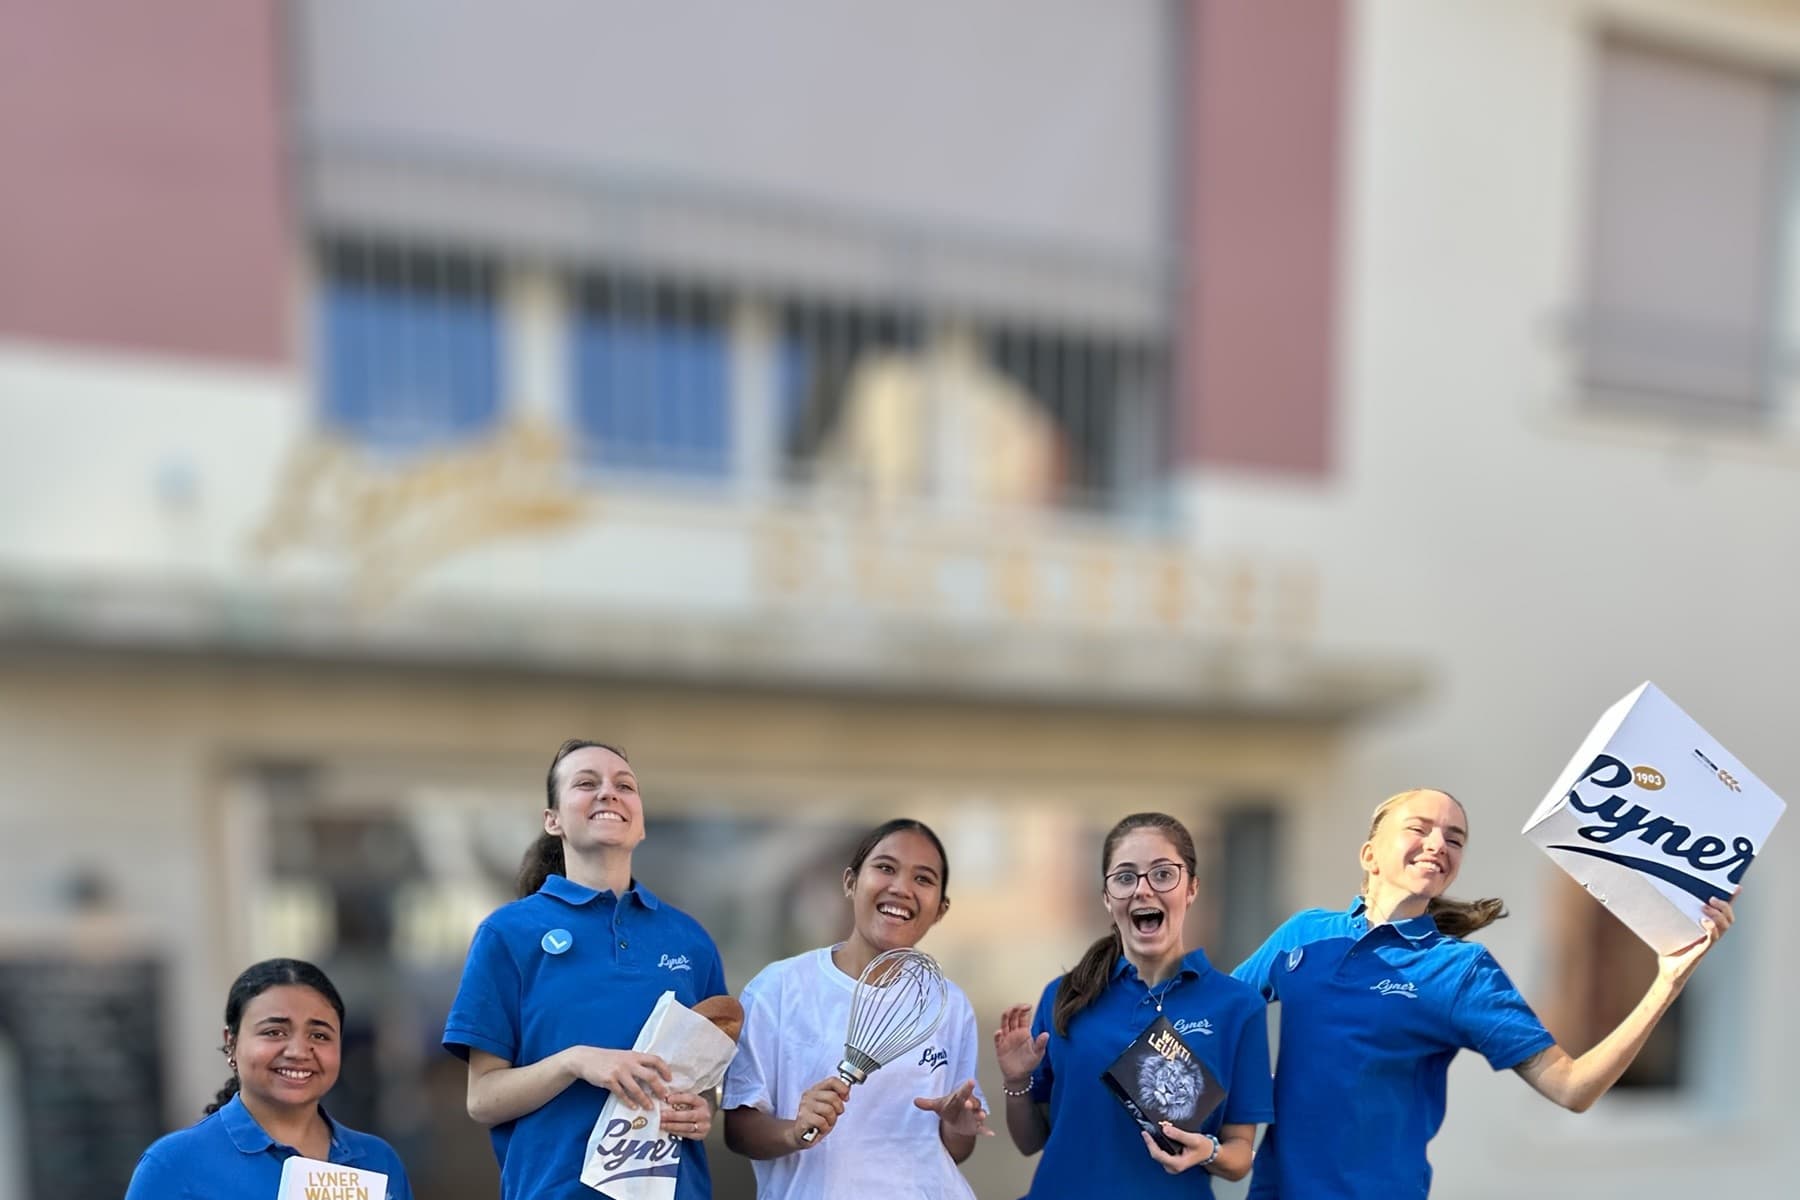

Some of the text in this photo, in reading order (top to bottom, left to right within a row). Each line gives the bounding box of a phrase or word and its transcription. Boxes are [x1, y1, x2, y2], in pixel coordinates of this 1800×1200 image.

[1635, 772, 1662, 786] 1903
[657, 953, 691, 969] Lyner
[1369, 978, 1419, 994] Lyner
[1161, 1030, 1192, 1062] WINTI
[308, 1171, 360, 1187] LYNER
